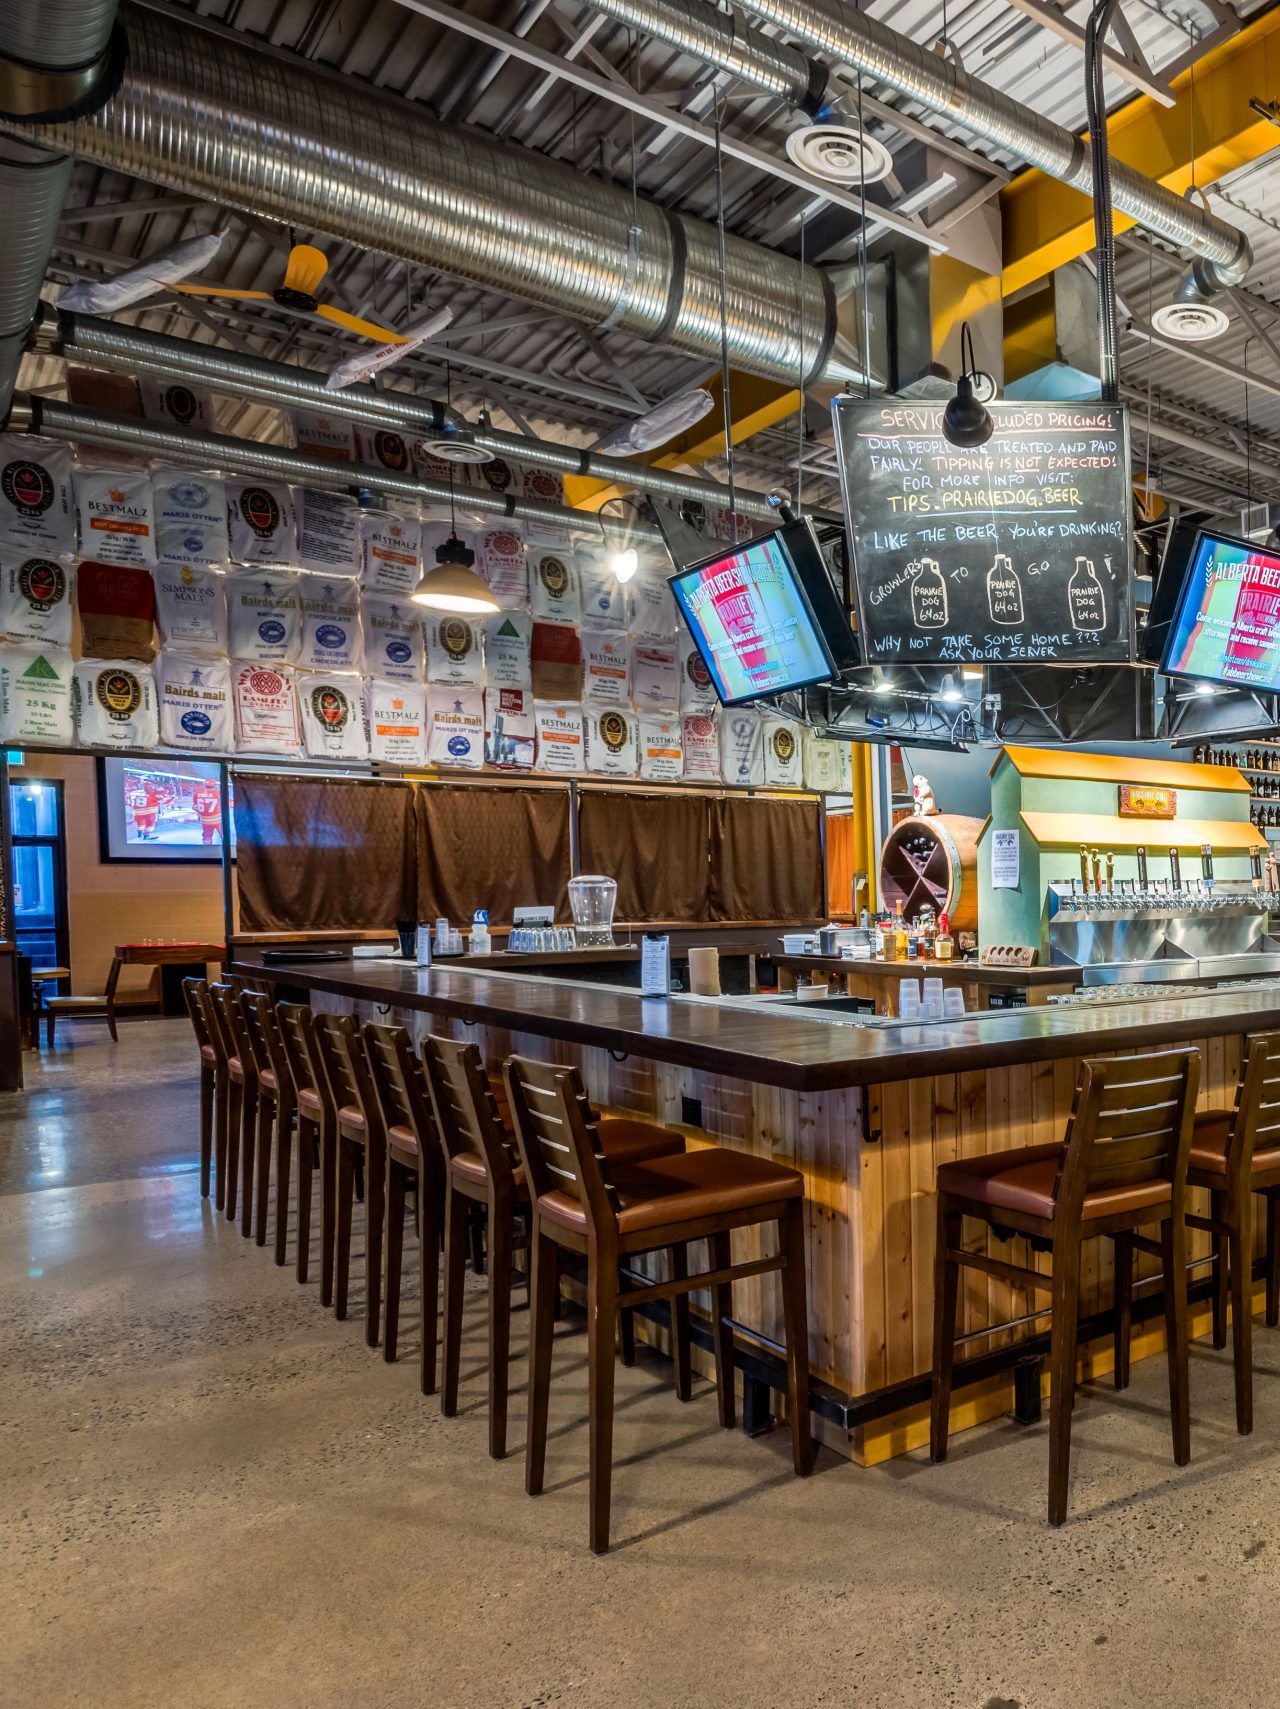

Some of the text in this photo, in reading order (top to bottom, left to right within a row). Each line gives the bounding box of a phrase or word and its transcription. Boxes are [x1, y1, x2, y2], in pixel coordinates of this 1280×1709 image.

[881, 409, 944, 430] SERVIC
[1048, 413, 1112, 428] PRICING!
[300, 428, 350, 443] BESTMALZ
[868, 438, 902, 454] OUR
[906, 440, 952, 454] PEOPLE
[993, 440, 1054, 454] TREATED
[1057, 442, 1086, 453] AND
[1089, 440, 1117, 454] PAID
[870, 455, 1117, 472] FAIRLY! TIPPING IS NOT EXPECTED!
[902, 472, 1074, 492] FOR MORE INFO VISIT:
[88, 500, 149, 518] BESTMALZ
[163, 511, 190, 519] MARIS
[874, 520, 1125, 549] LIKE THE BEER YOU'RE DRINKING?
[372, 533, 418, 551] BESTMALZ
[1216, 563, 1259, 583] ALBERTA
[690, 578, 719, 609] ALBERTA
[713, 569, 734, 595] BEER
[869, 559, 922, 605] GROWLERS
[950, 566, 969, 583] TO
[1027, 560, 1050, 575] GO
[990, 580, 1017, 590] PRAIRIE
[161, 583, 215, 597] SIMPSONS
[174, 592, 204, 602] MALT
[914, 586, 944, 597] PRAIRIE
[994, 589, 1015, 598] DOG
[1071, 586, 1099, 598] PRAIRIE
[241, 595, 296, 609] Bairds malt
[922, 597, 940, 606] DOG
[1075, 598, 1096, 607] DOG
[308, 613, 351, 622] CHOCOLATE
[371, 616, 399, 630] Bairds
[1196, 612, 1213, 623] Come
[1236, 620, 1256, 633] Alberta
[1255, 627, 1269, 637] craft
[874, 631, 1101, 652] WHY NOT TAKE SOME HOME ???
[1229, 633, 1241, 642] and
[1240, 635, 1259, 647] receive
[1259, 640, 1280, 651] samples
[590, 652, 627, 665] BESTMALZ
[940, 646, 1057, 661] ASK YOUR SERVER
[311, 657, 352, 666] CHOCOLATE
[165, 684, 200, 699] Bairds
[203, 690, 226, 701] malt
[26, 699, 57, 711] 25 Kg
[163, 700, 190, 709] MARIS
[183, 712, 210, 726] ASSURED
[375, 710, 419, 720] BESTMALZ
[434, 712, 482, 726] Bairds malt
[436, 725, 458, 733] MARIS
[541, 718, 580, 730] BESTMALZ
[196, 798, 218, 813] 67
